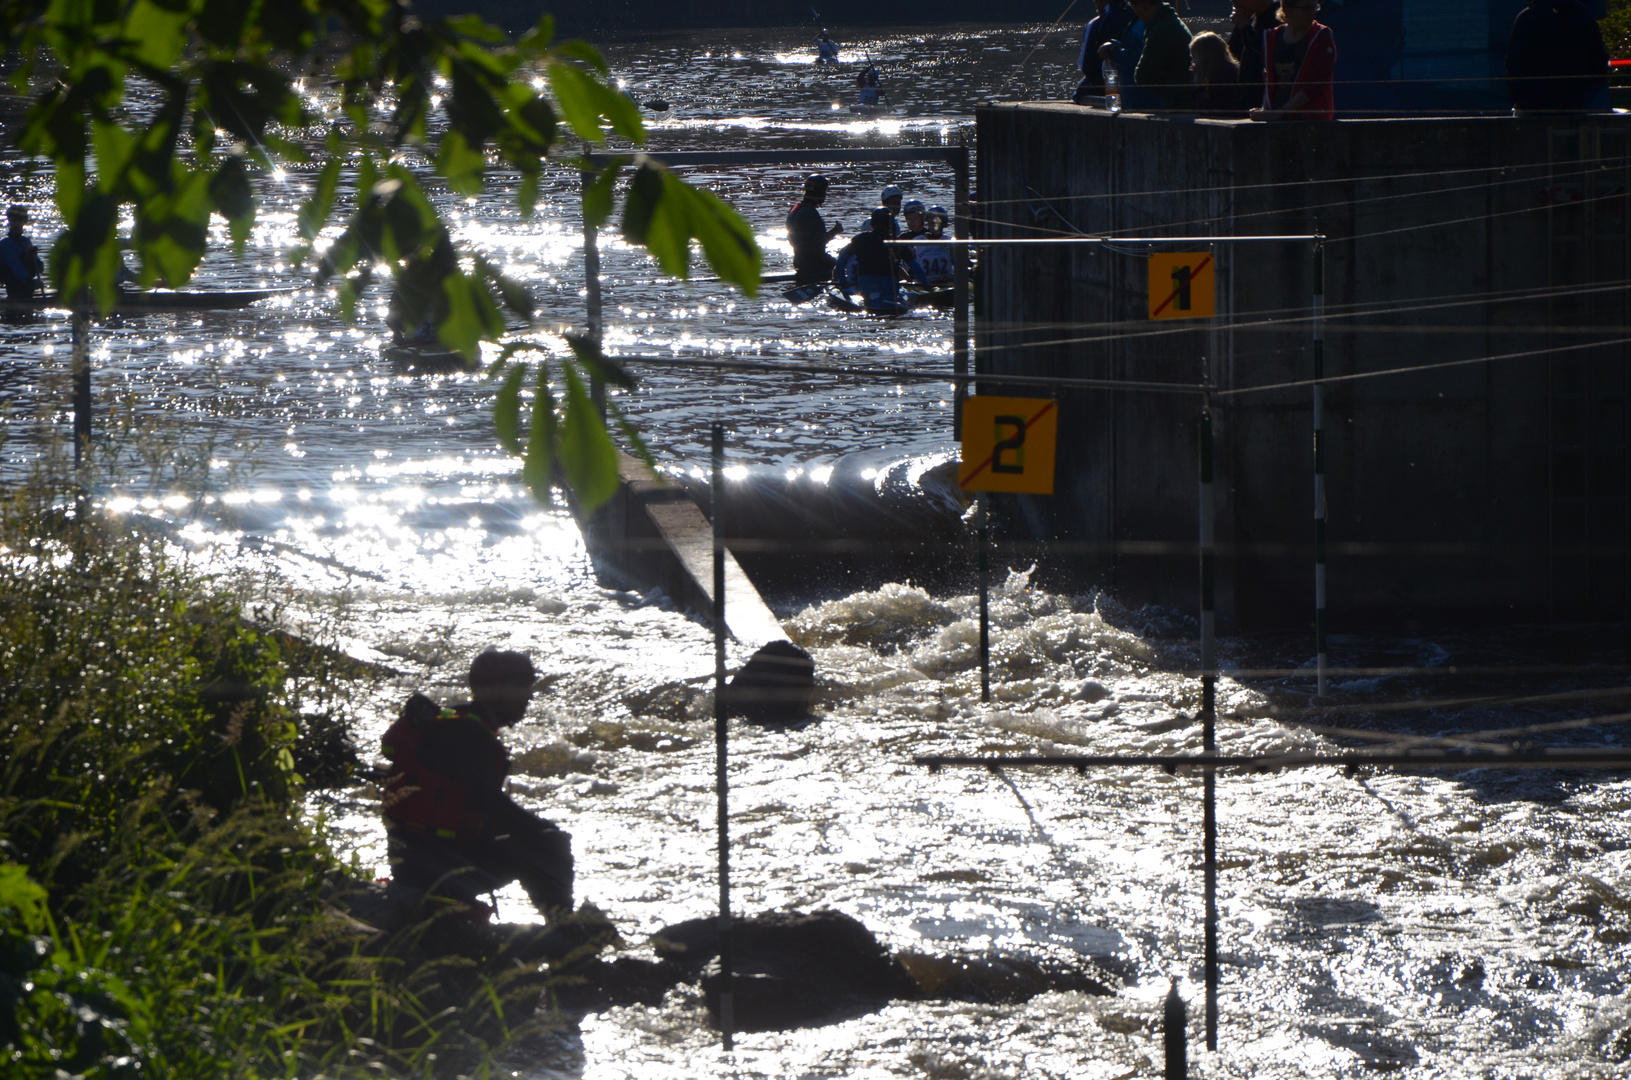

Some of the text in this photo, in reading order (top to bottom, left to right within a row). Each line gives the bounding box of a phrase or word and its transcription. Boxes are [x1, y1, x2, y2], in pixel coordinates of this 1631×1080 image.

[922, 258, 948, 275] 342
[1171, 265, 1191, 310] 1
[991, 415, 1026, 474] 2
